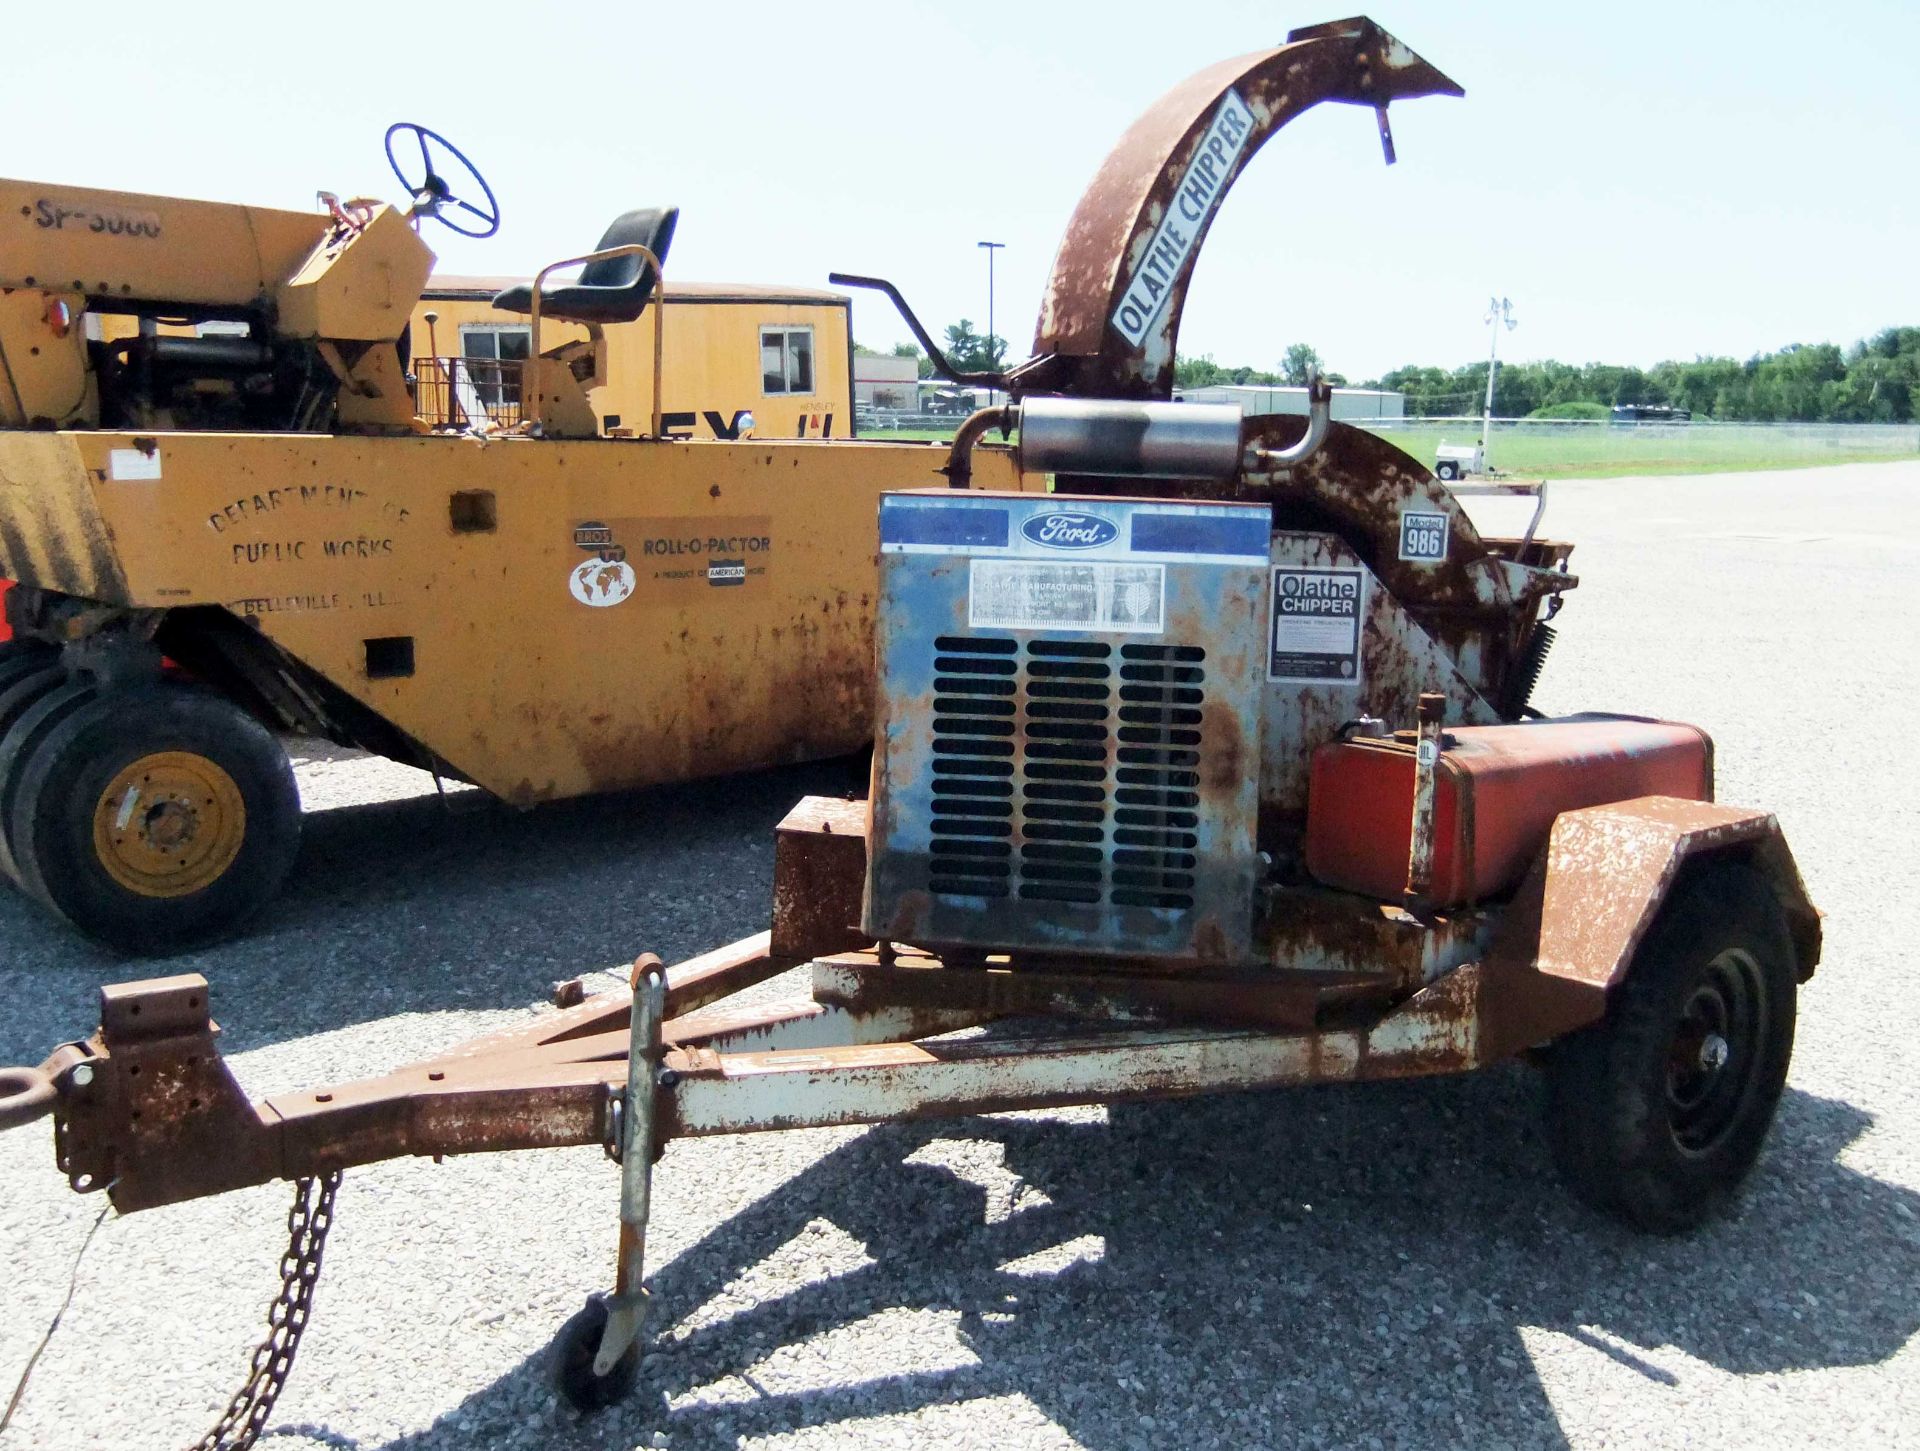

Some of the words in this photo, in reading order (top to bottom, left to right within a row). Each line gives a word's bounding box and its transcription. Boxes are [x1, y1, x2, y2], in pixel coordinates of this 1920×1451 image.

[1119, 220, 1188, 335] OLATHE
[1178, 106, 1247, 223] CHIPPER
[1039, 515, 1100, 543] Ford
[1409, 517, 1440, 528] Model
[323, 538, 393, 559] WORKS
[1407, 528, 1440, 555] 986
[710, 568, 745, 577] AMERICAN
[1282, 576, 1355, 598] Olathe
[1281, 597, 1354, 614] CHIPPER
[1419, 744, 1431, 760] OIL
